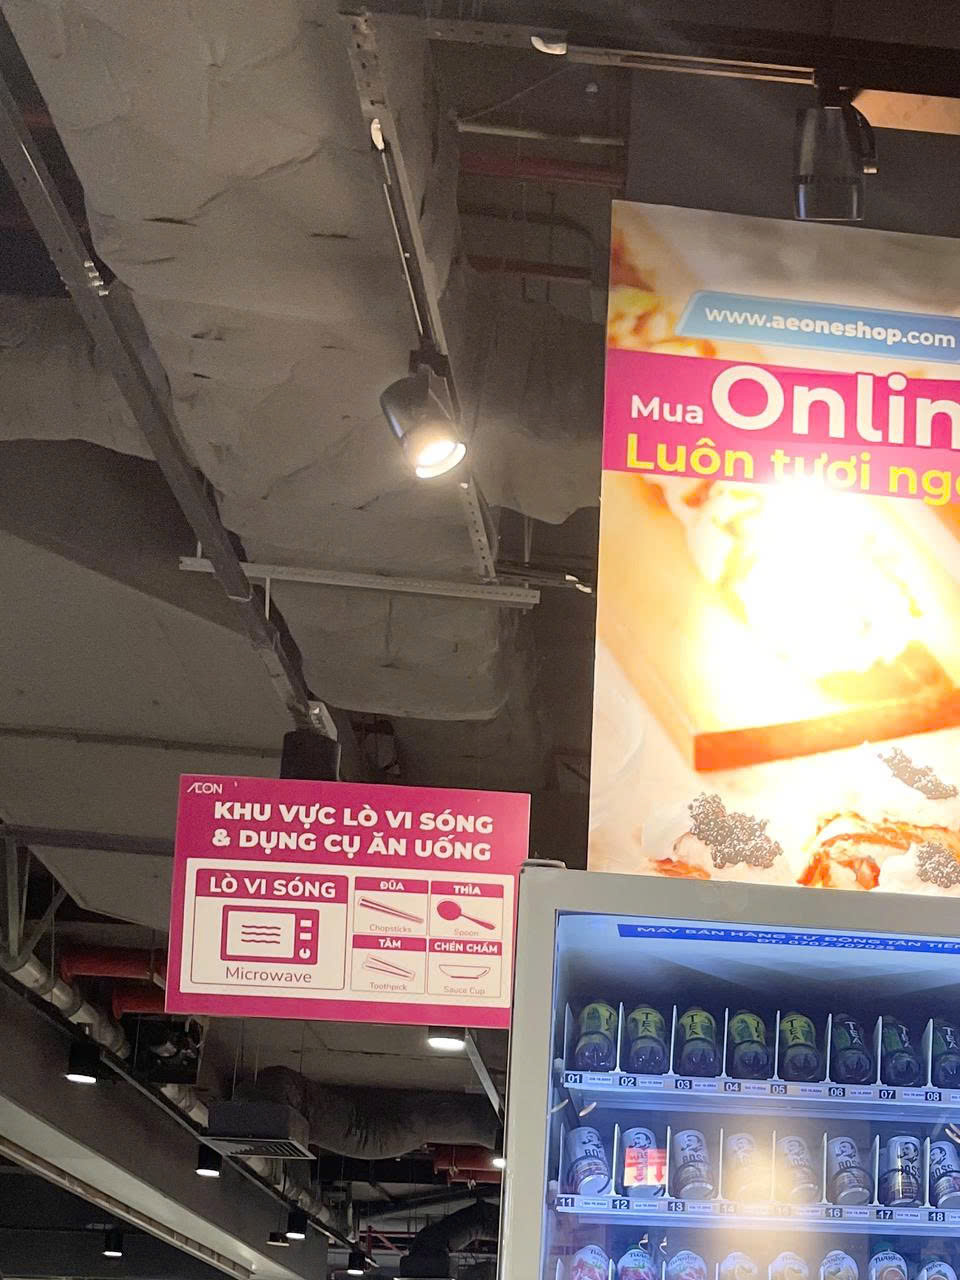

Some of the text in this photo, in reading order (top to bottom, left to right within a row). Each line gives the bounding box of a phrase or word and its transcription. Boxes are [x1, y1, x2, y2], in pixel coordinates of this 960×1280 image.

[705, 307, 956, 348] www.aeoneshop.com
[631, 394, 704, 425] Mua
[626, 433, 754, 479] Luôn
[214, 801, 494, 834] KHU VỰC LÒ VI SÓNG
[212, 829, 491, 861] & DỤNG CỤ ĂN UỐNG
[210, 873, 336, 898] LÒ VI SÓNG
[453, 883, 481, 895] THÌA
[369, 923, 412, 934] Chopsticks
[453, 928, 479, 938] Spoon
[434, 940, 464, 953] CHÉN
[225, 966, 312, 984] Microwave
[369, 981, 408, 992] Toothpick
[443, 985, 486, 997] Sauce Cup
[687, 1013, 699, 1038] TEA
[785, 1018, 801, 1042] TEA
[568, 1074, 582, 1083] 01
[621, 1077, 635, 1086] 02
[677, 1080, 691, 1089] 03
[725, 1083, 739, 1092] 04
[772, 1085, 786, 1094] 05
[830, 1088, 844, 1097] 06
[881, 1090, 895, 1099] 07
[926, 1092, 940, 1101] 08
[931, 1163, 954, 1181] BOSS
[560, 1198, 573, 1207] 11
[614, 1199, 628, 1209] 12
[669, 1202, 684, 1211] 13
[827, 1208, 841, 1217] 16
[877, 1210, 892, 1219] 17
[929, 1212, 943, 1221] 18
